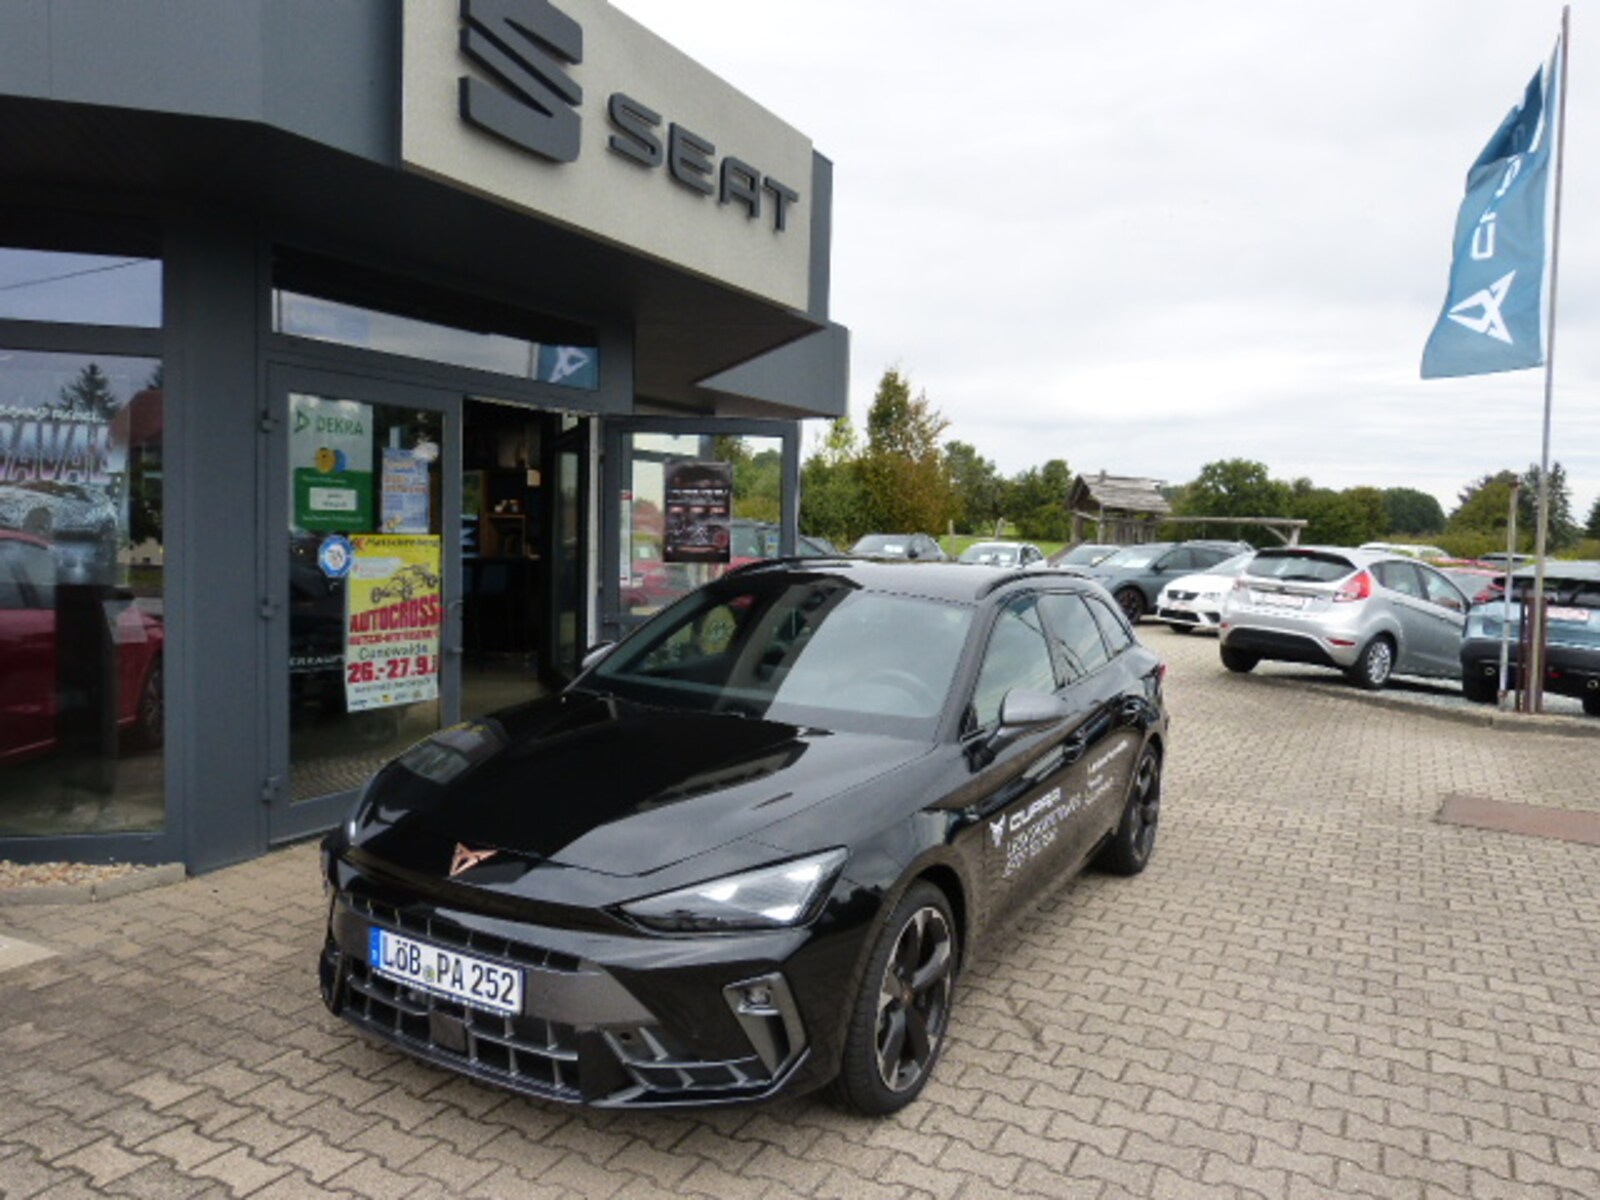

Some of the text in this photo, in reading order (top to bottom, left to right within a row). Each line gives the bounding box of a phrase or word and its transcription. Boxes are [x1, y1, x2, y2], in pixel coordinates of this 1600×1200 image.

[608, 91, 799, 232] SEAT
[316, 415, 363, 435] DEKRA
[350, 593, 443, 633] AUTOCROSS
[1009, 787, 1061, 832] CUPRA
[437, 952, 464, 991] PA
[471, 964, 515, 1006] 252
